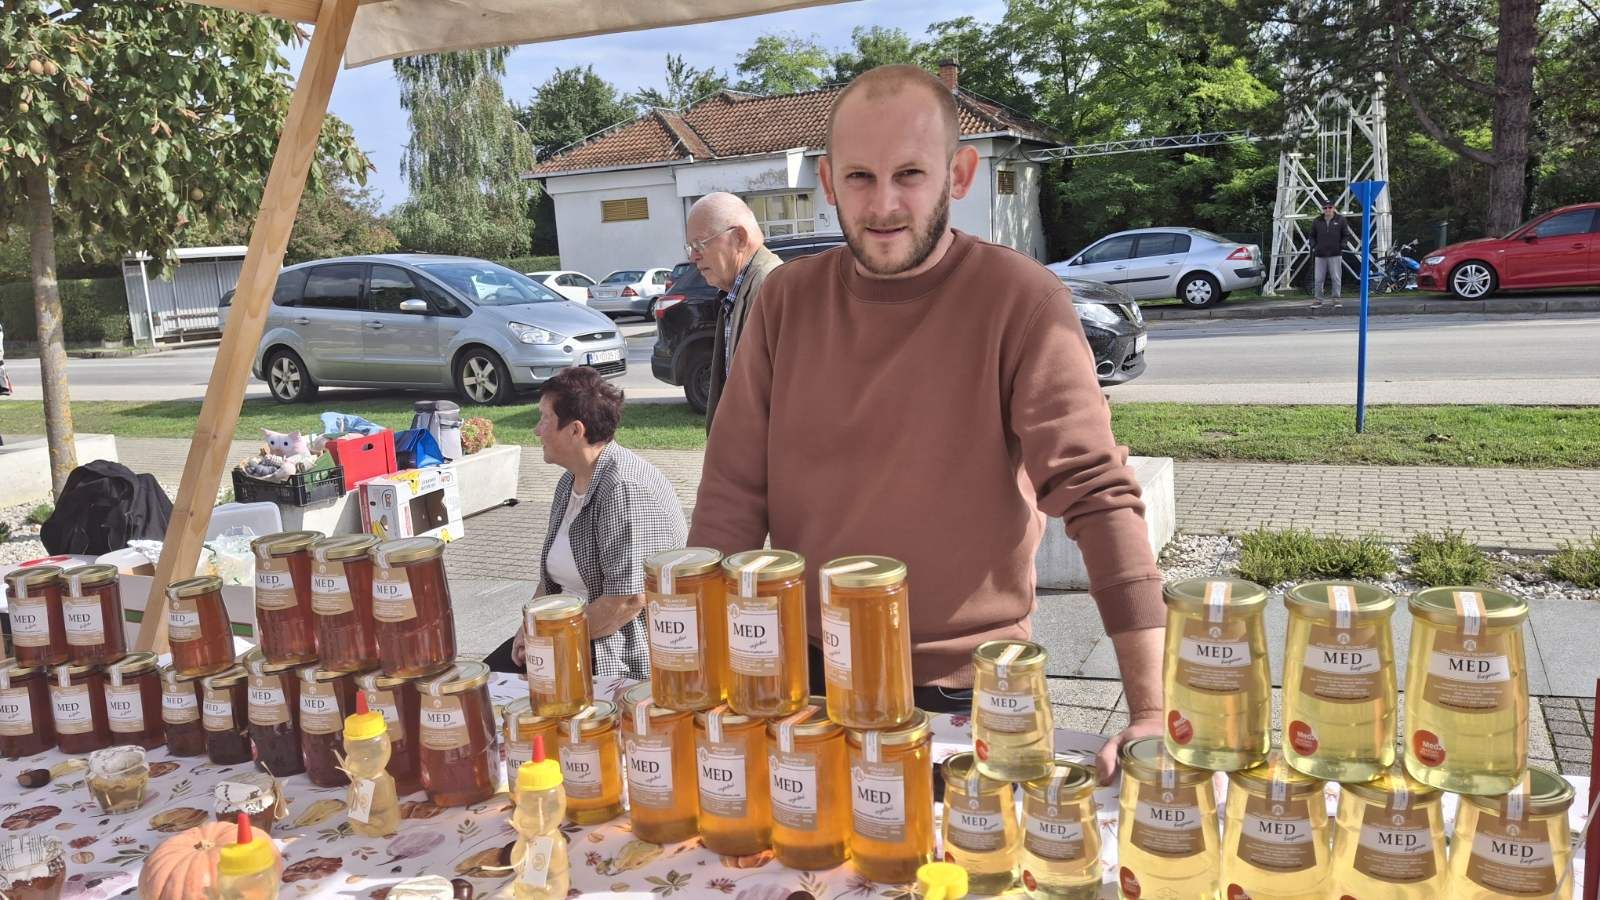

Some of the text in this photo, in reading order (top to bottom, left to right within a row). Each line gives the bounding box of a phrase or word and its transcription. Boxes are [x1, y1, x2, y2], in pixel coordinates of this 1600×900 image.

[259, 574, 279, 584] MED
[314, 578, 335, 588] MED
[376, 584, 398, 594] MED
[14, 614, 36, 624] MED
[68, 613, 91, 624] MED
[655, 619, 685, 634] MED
[733, 622, 765, 638] MED
[1196, 644, 1233, 659] MED
[1323, 651, 1362, 666] MED
[1449, 658, 1490, 673] MED
[166, 696, 183, 704] MED
[251, 691, 272, 700] MED
[57, 703, 79, 713] MED
[111, 701, 131, 711] MED
[304, 699, 325, 709] MED
[991, 696, 1017, 708] MED
[427, 713, 451, 723] MED
[566, 762, 590, 772] MED
[631, 758, 660, 773] MED
[702, 765, 733, 781] MED
[773, 775, 803, 793] MED
[857, 786, 891, 804] MED
[961, 815, 988, 826] MED
[1151, 807, 1185, 822] MED
[1039, 822, 1066, 835] MED
[1259, 821, 1296, 835] MED
[1378, 832, 1417, 846] MED
[1491, 841, 1534, 858] MED
